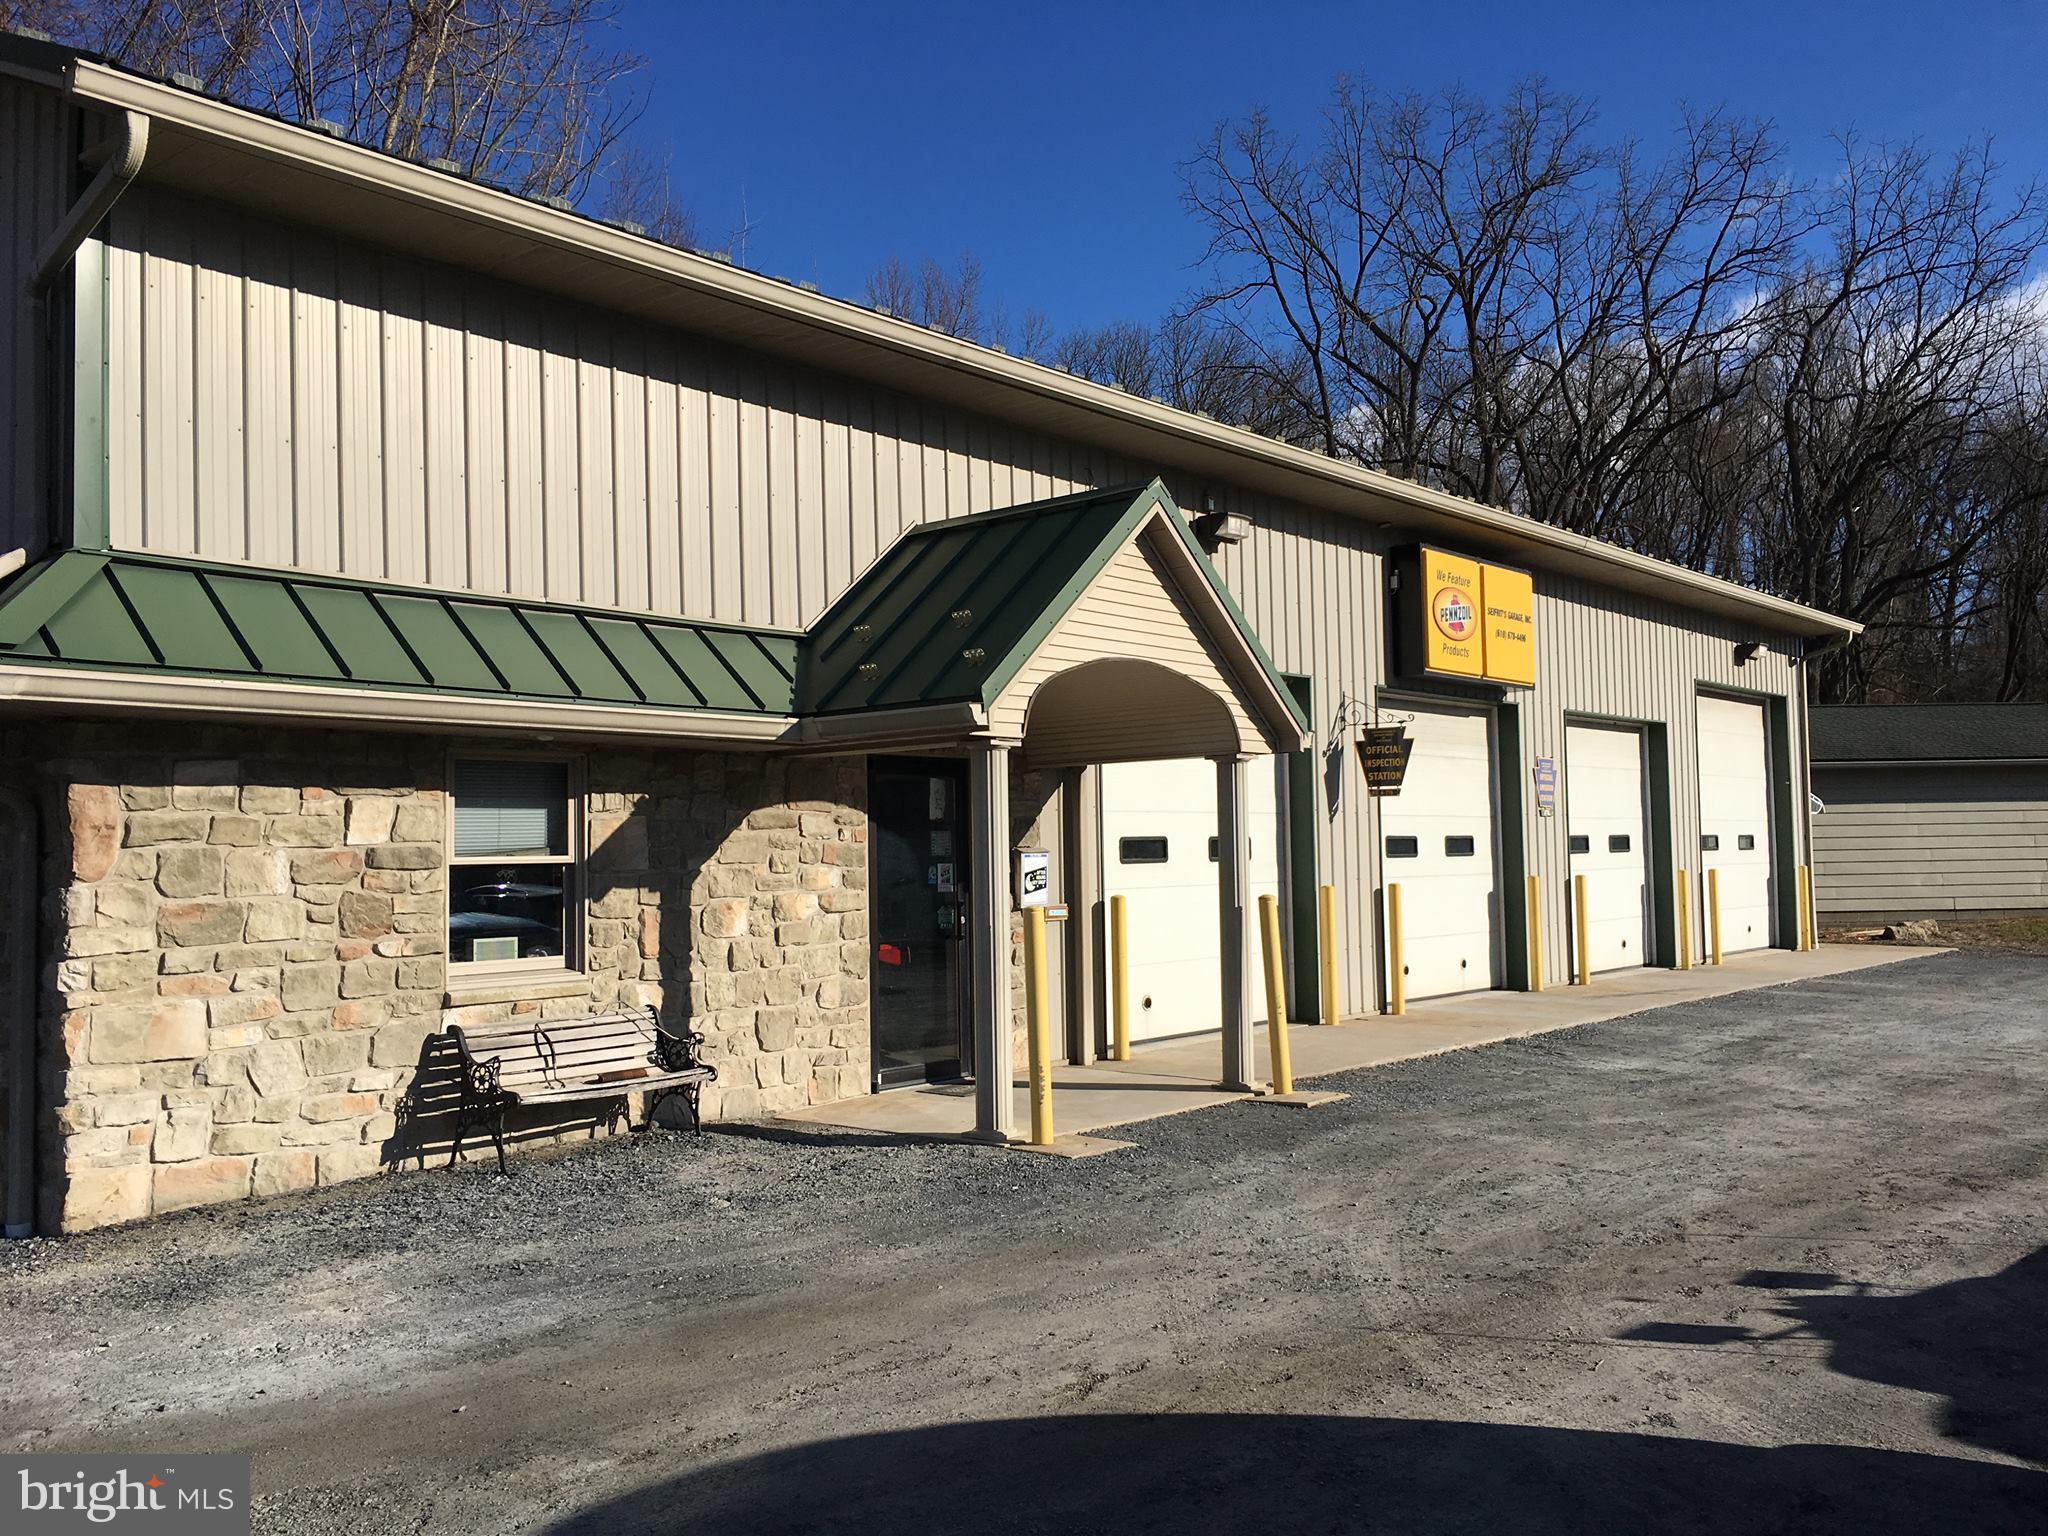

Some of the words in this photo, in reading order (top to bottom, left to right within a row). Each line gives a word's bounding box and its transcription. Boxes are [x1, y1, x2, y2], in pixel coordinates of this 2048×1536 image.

[1436, 569, 1446, 581] We
[1447, 572, 1471, 587] Feature
[1440, 605, 1472, 622] PENNZOIL
[1442, 643, 1470, 658] Products
[1366, 745, 1404, 755] OFFICIAL
[1364, 758, 1406, 767] INSPECTION
[1368, 771, 1402, 781] STATION
